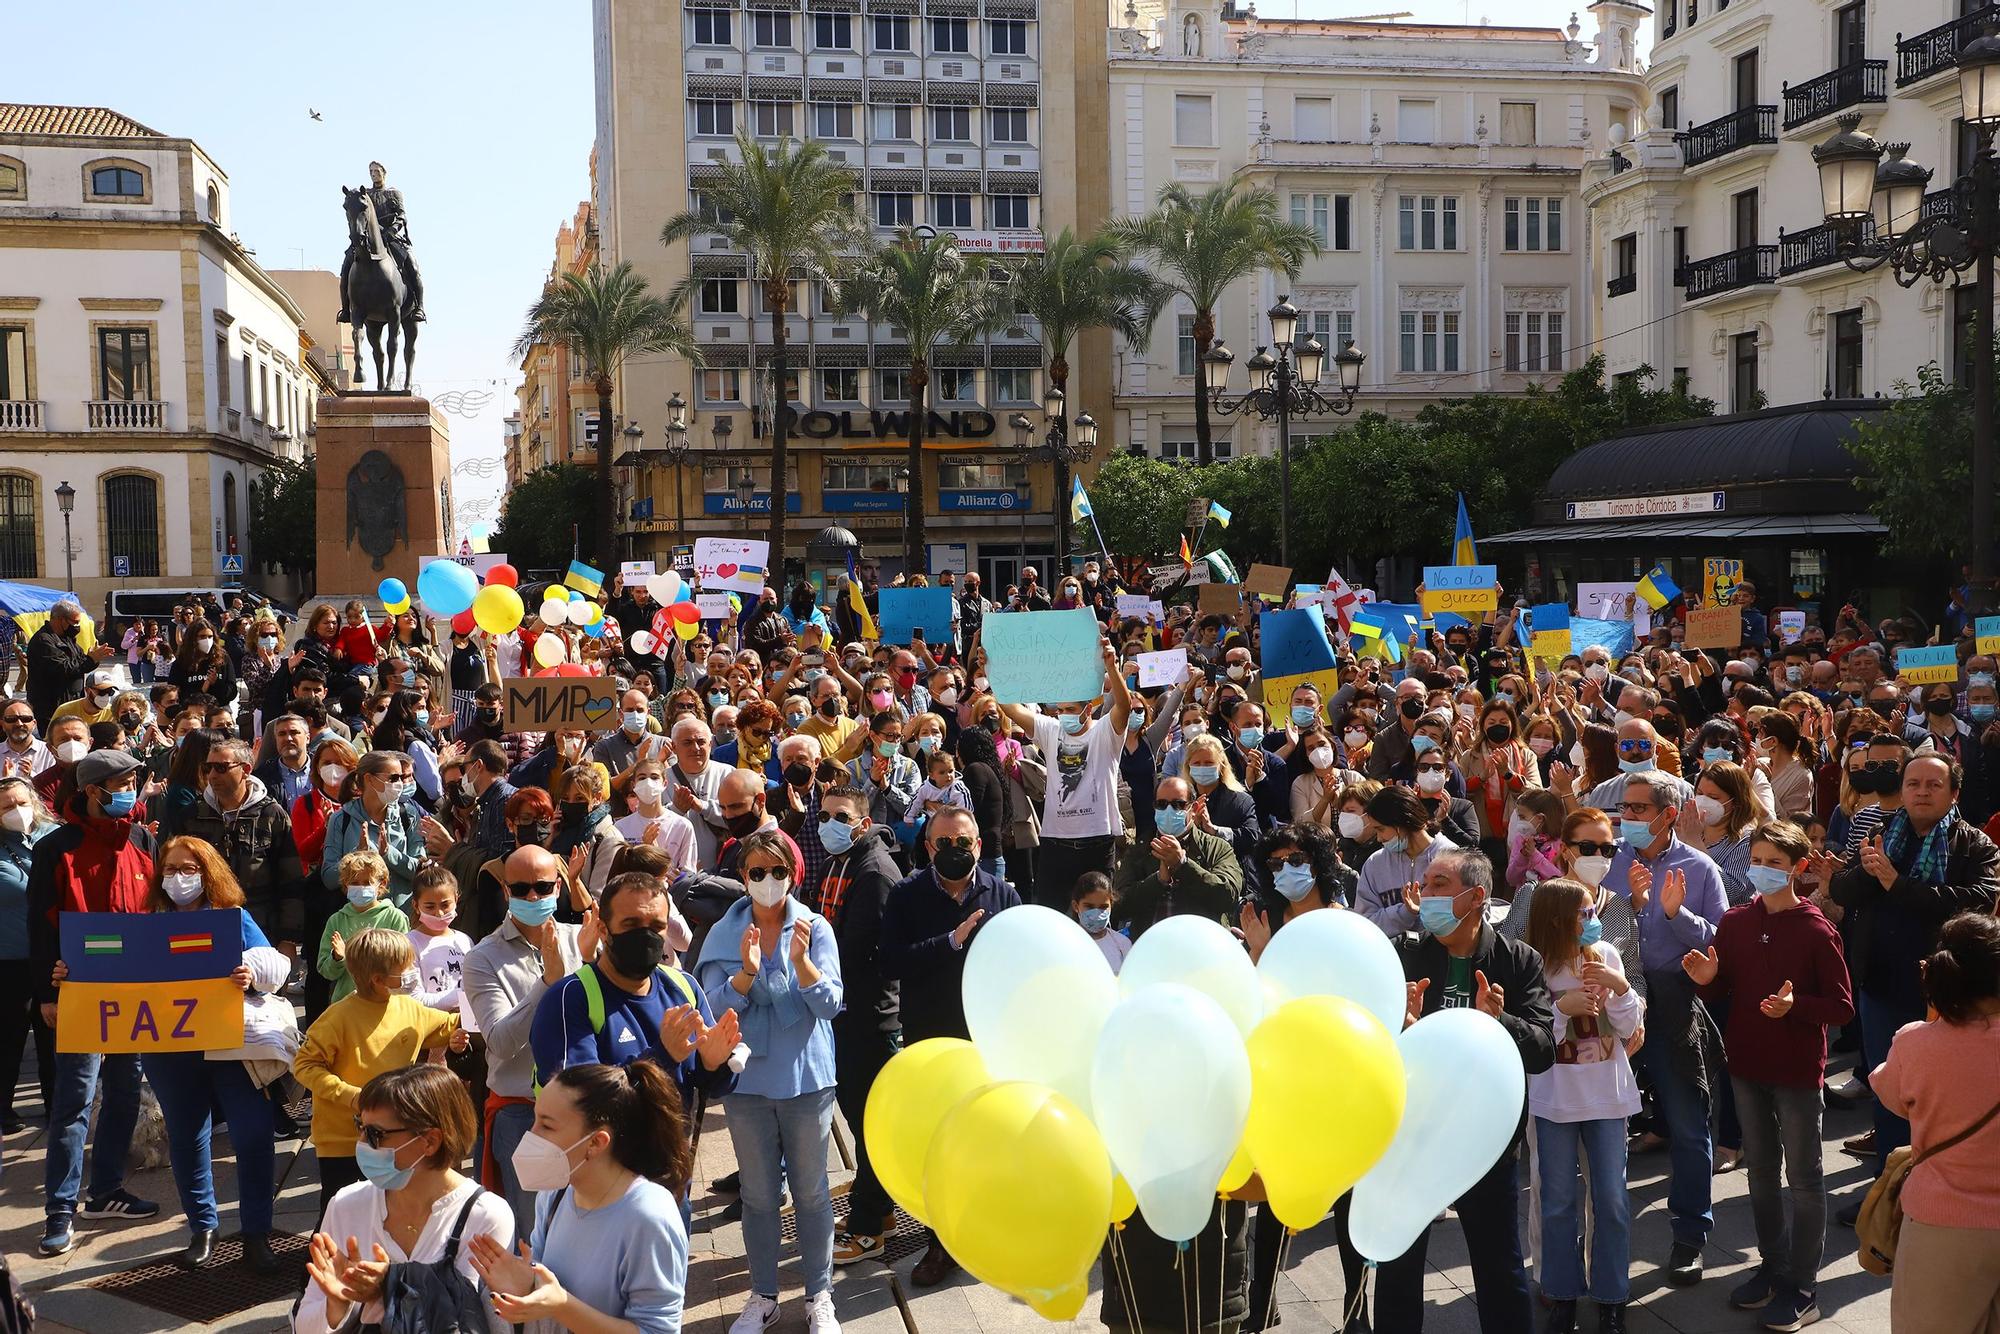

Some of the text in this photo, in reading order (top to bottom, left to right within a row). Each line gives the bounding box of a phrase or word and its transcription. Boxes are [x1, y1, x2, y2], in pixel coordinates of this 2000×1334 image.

[954, 238, 992, 248] mbrella
[957, 495, 997, 506] Allianz
[1607, 501, 1633, 516] Turismo
[1634, 500, 1645, 515] de
[1646, 498, 1677, 513] Córdoba
[674, 554, 693, 565] НЕТ
[1708, 560, 1740, 577] STOP
[1433, 568, 1483, 587] No a la
[1903, 653, 1919, 665] NO
[509, 684, 592, 724] МИР
[99, 998, 198, 1043] PAZ
